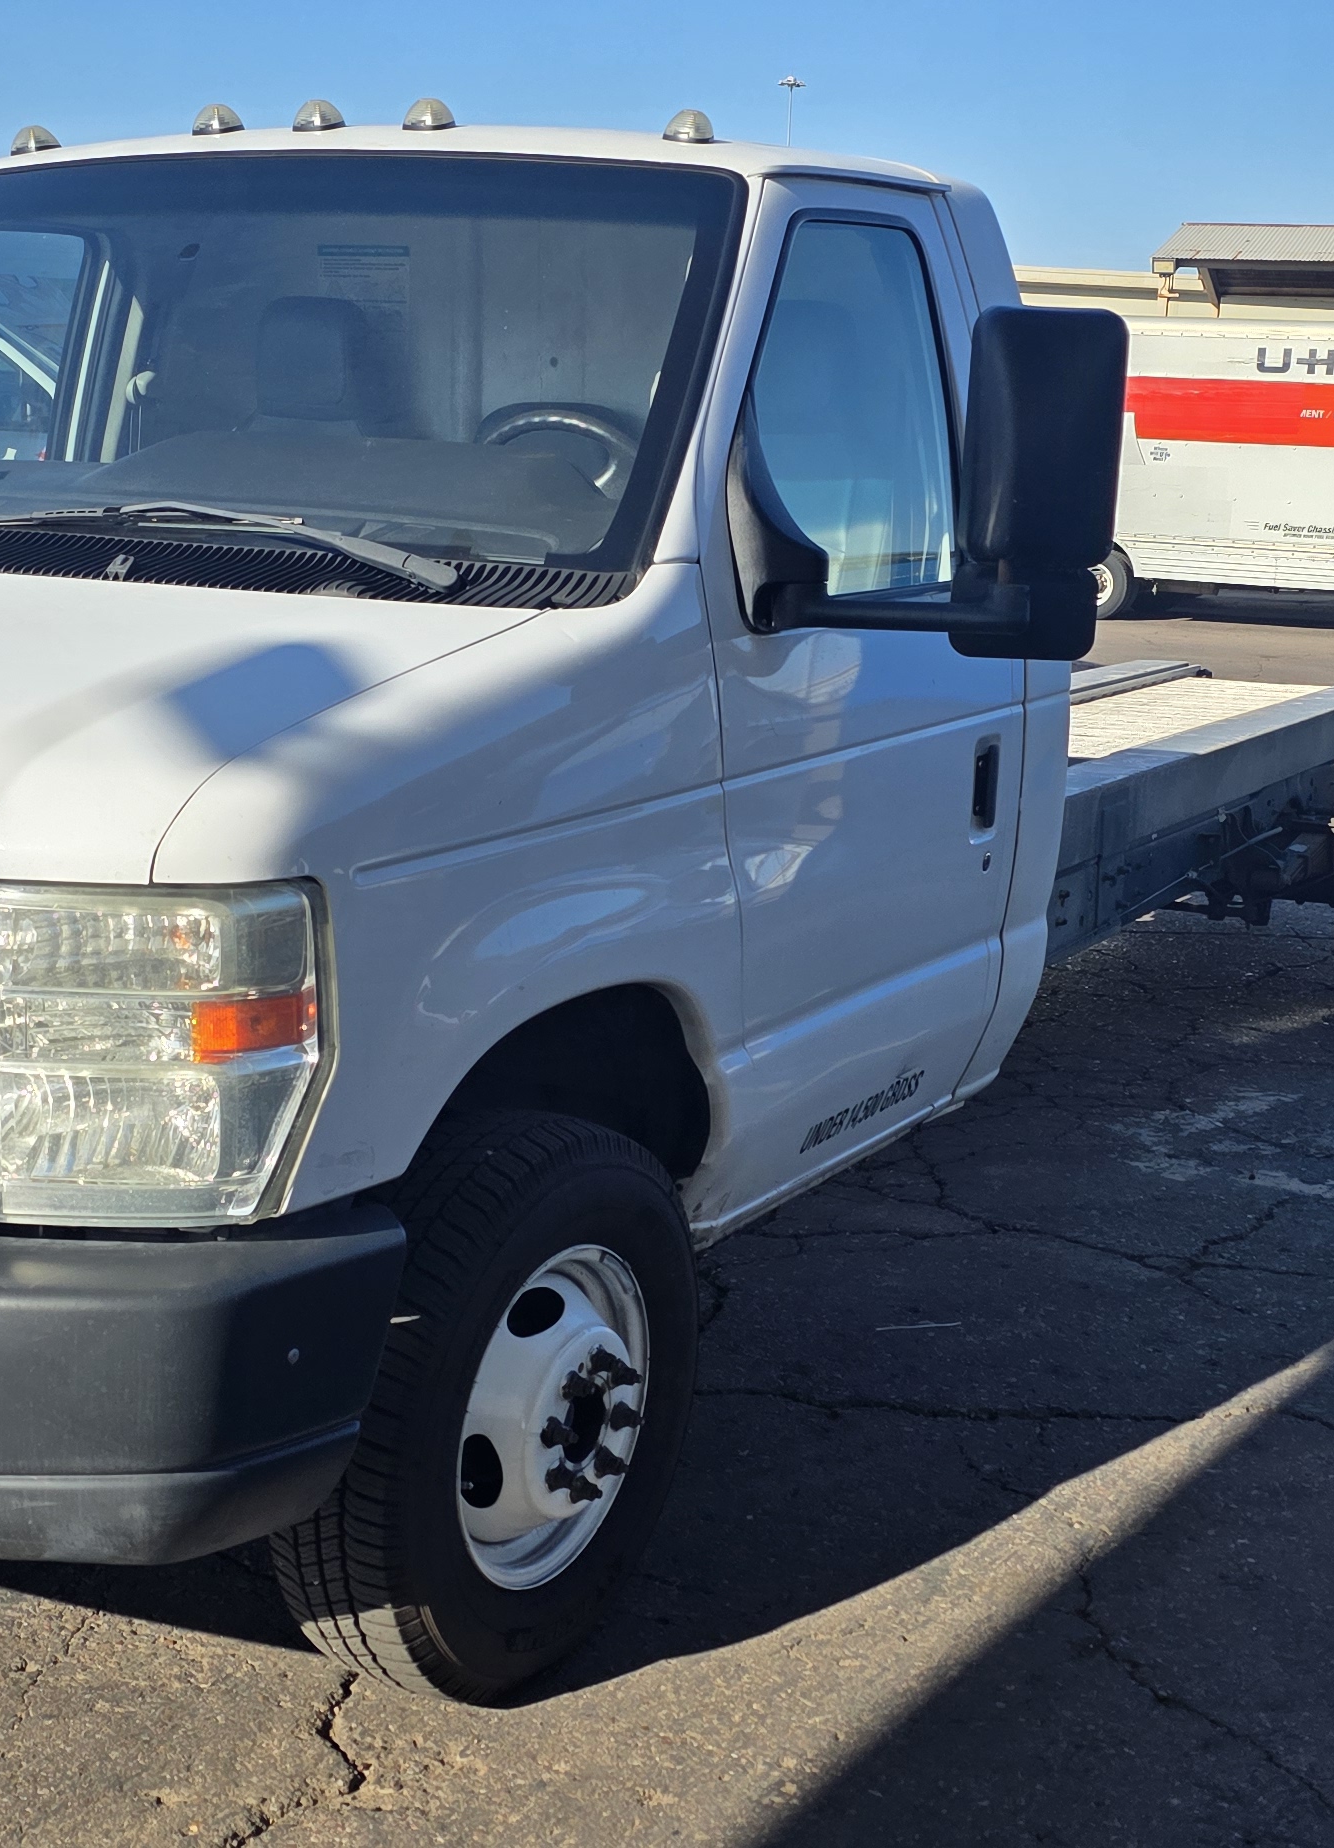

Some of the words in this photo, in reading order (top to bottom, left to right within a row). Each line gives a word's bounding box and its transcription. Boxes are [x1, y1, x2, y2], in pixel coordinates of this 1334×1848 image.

[1263, 522, 1282, 532] Fuel
[1282, 523, 1307, 534] Saver
[799, 1107, 850, 1155] UNDER
[843, 1089, 887, 1132] 14,500
[878, 1069, 926, 1113] GROSS
